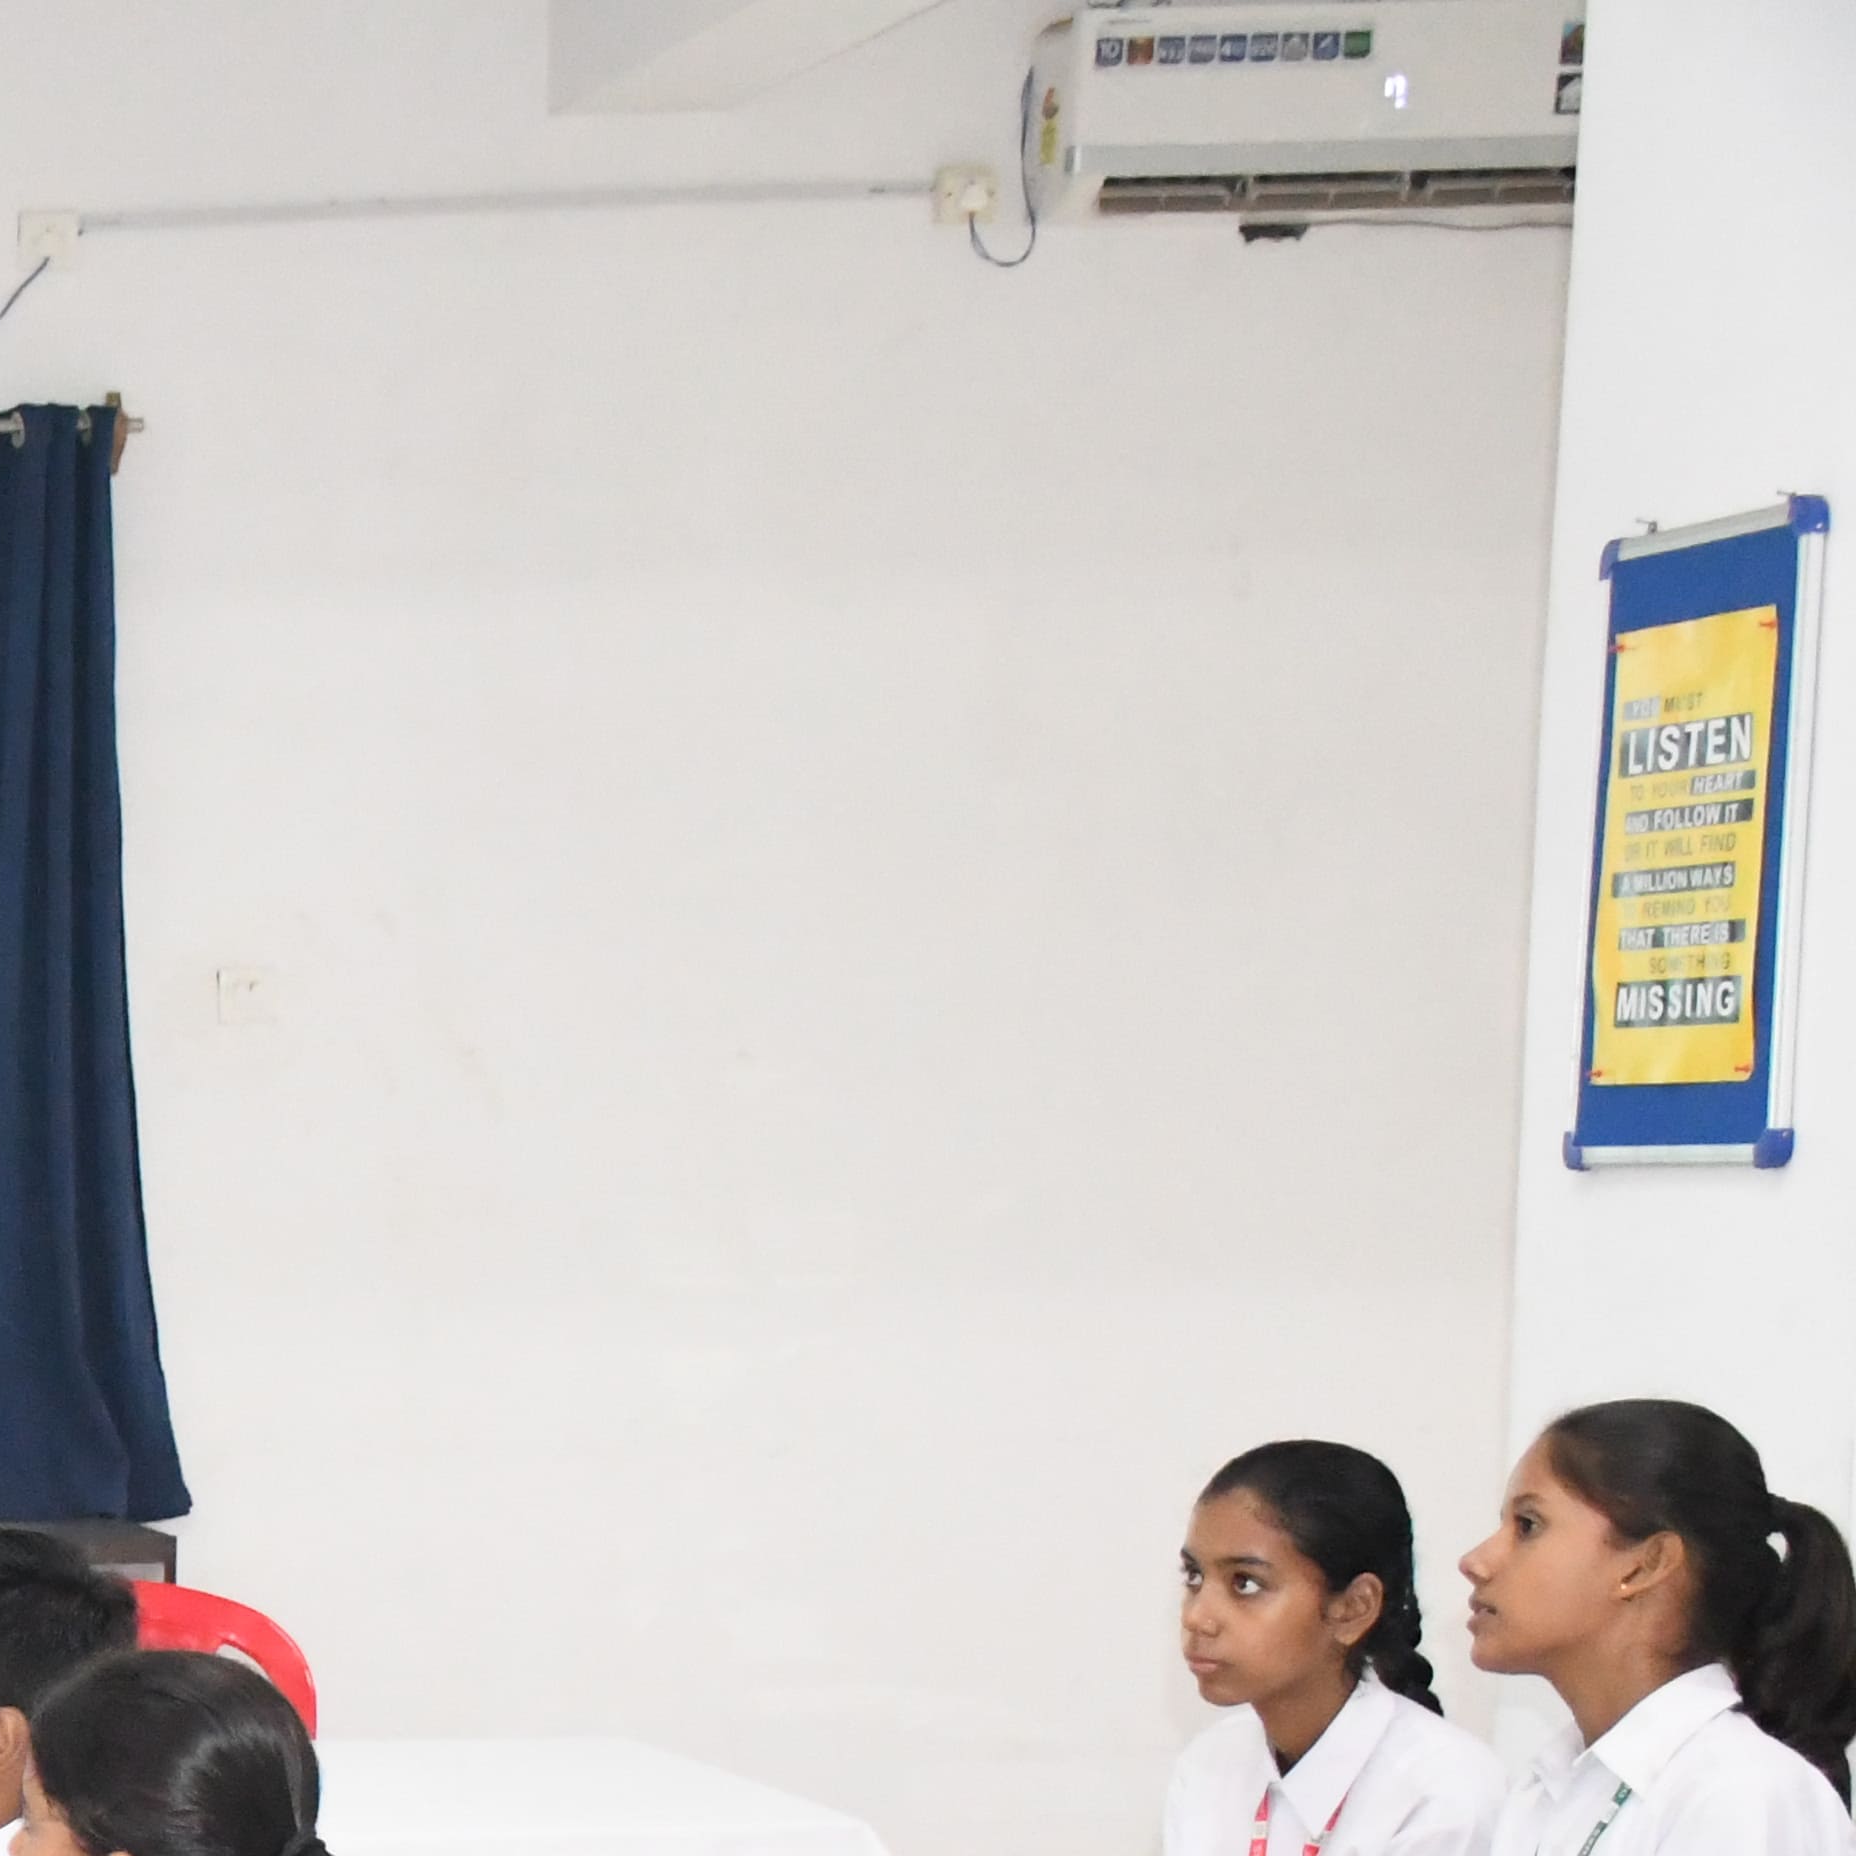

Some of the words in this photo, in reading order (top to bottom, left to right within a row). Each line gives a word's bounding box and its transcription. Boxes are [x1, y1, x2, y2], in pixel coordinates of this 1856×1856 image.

[1628, 714, 1752, 776] LISTEN
[1693, 772, 1744, 794] HEART
[1653, 803, 1722, 831] FOLLOW
[1724, 802, 1740, 822] IT
[1699, 832, 1737, 853] FIND
[1633, 868, 1689, 892] MILLION
[1690, 863, 1734, 888] WAYS
[1620, 928, 1655, 950] THAT
[1663, 923, 1710, 947] THERE
[1713, 920, 1730, 941] IS
[1649, 951, 1731, 975] SOTHG
[1616, 980, 1736, 1021] MISSING
